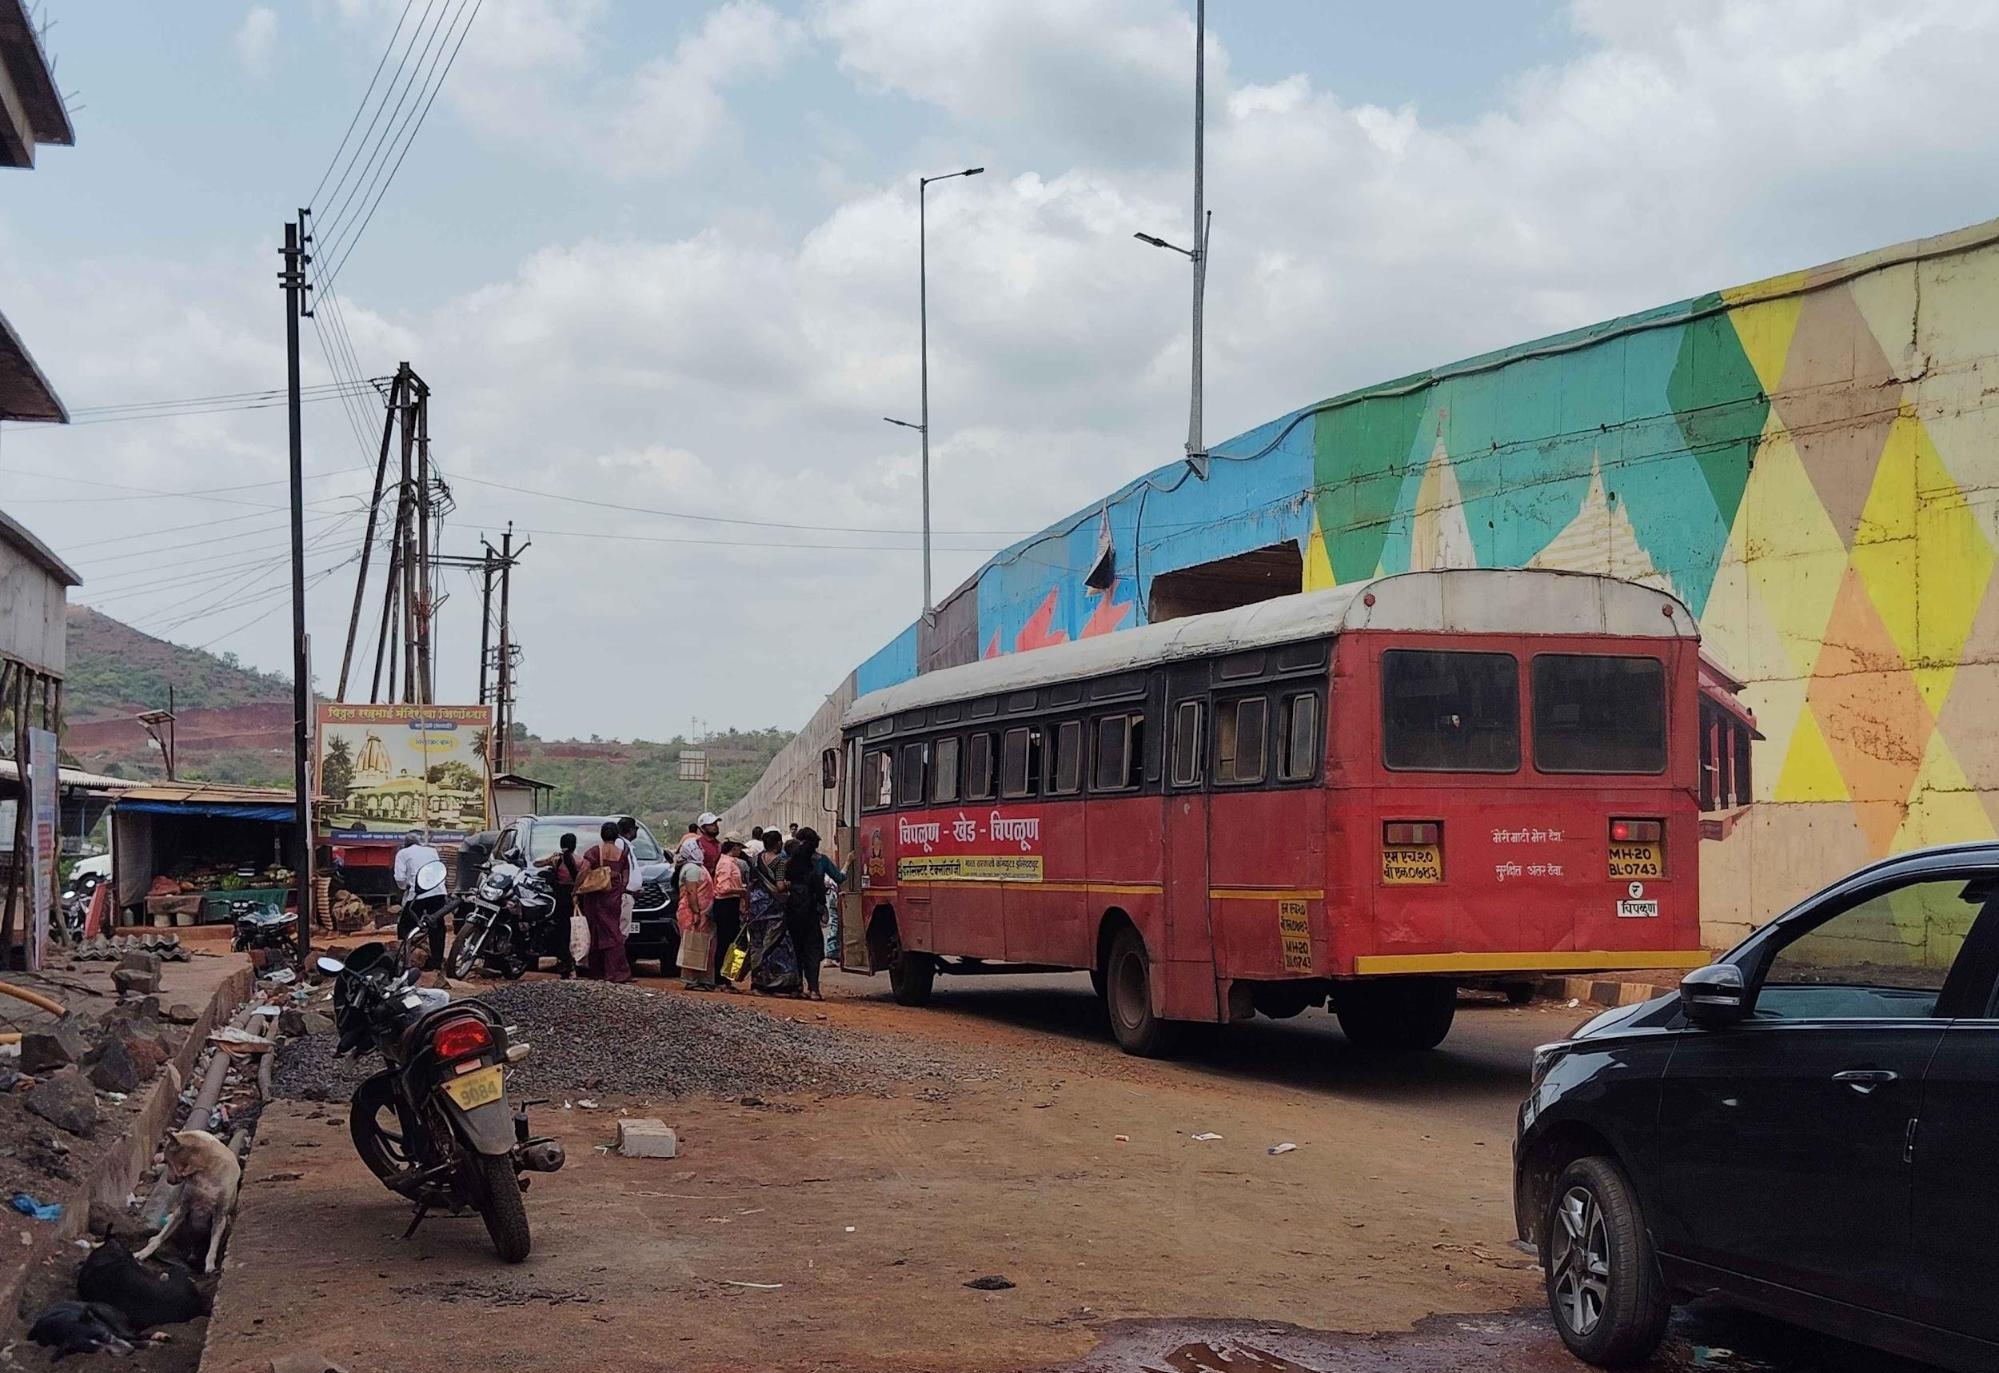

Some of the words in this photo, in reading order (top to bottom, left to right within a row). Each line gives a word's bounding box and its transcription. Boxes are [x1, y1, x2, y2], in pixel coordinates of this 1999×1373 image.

[899, 816, 940, 853] चिपळूण
[952, 812, 976, 842] खेड
[990, 810, 1040, 851] चिपळूण
[461, 1081, 498, 1106] 9084
